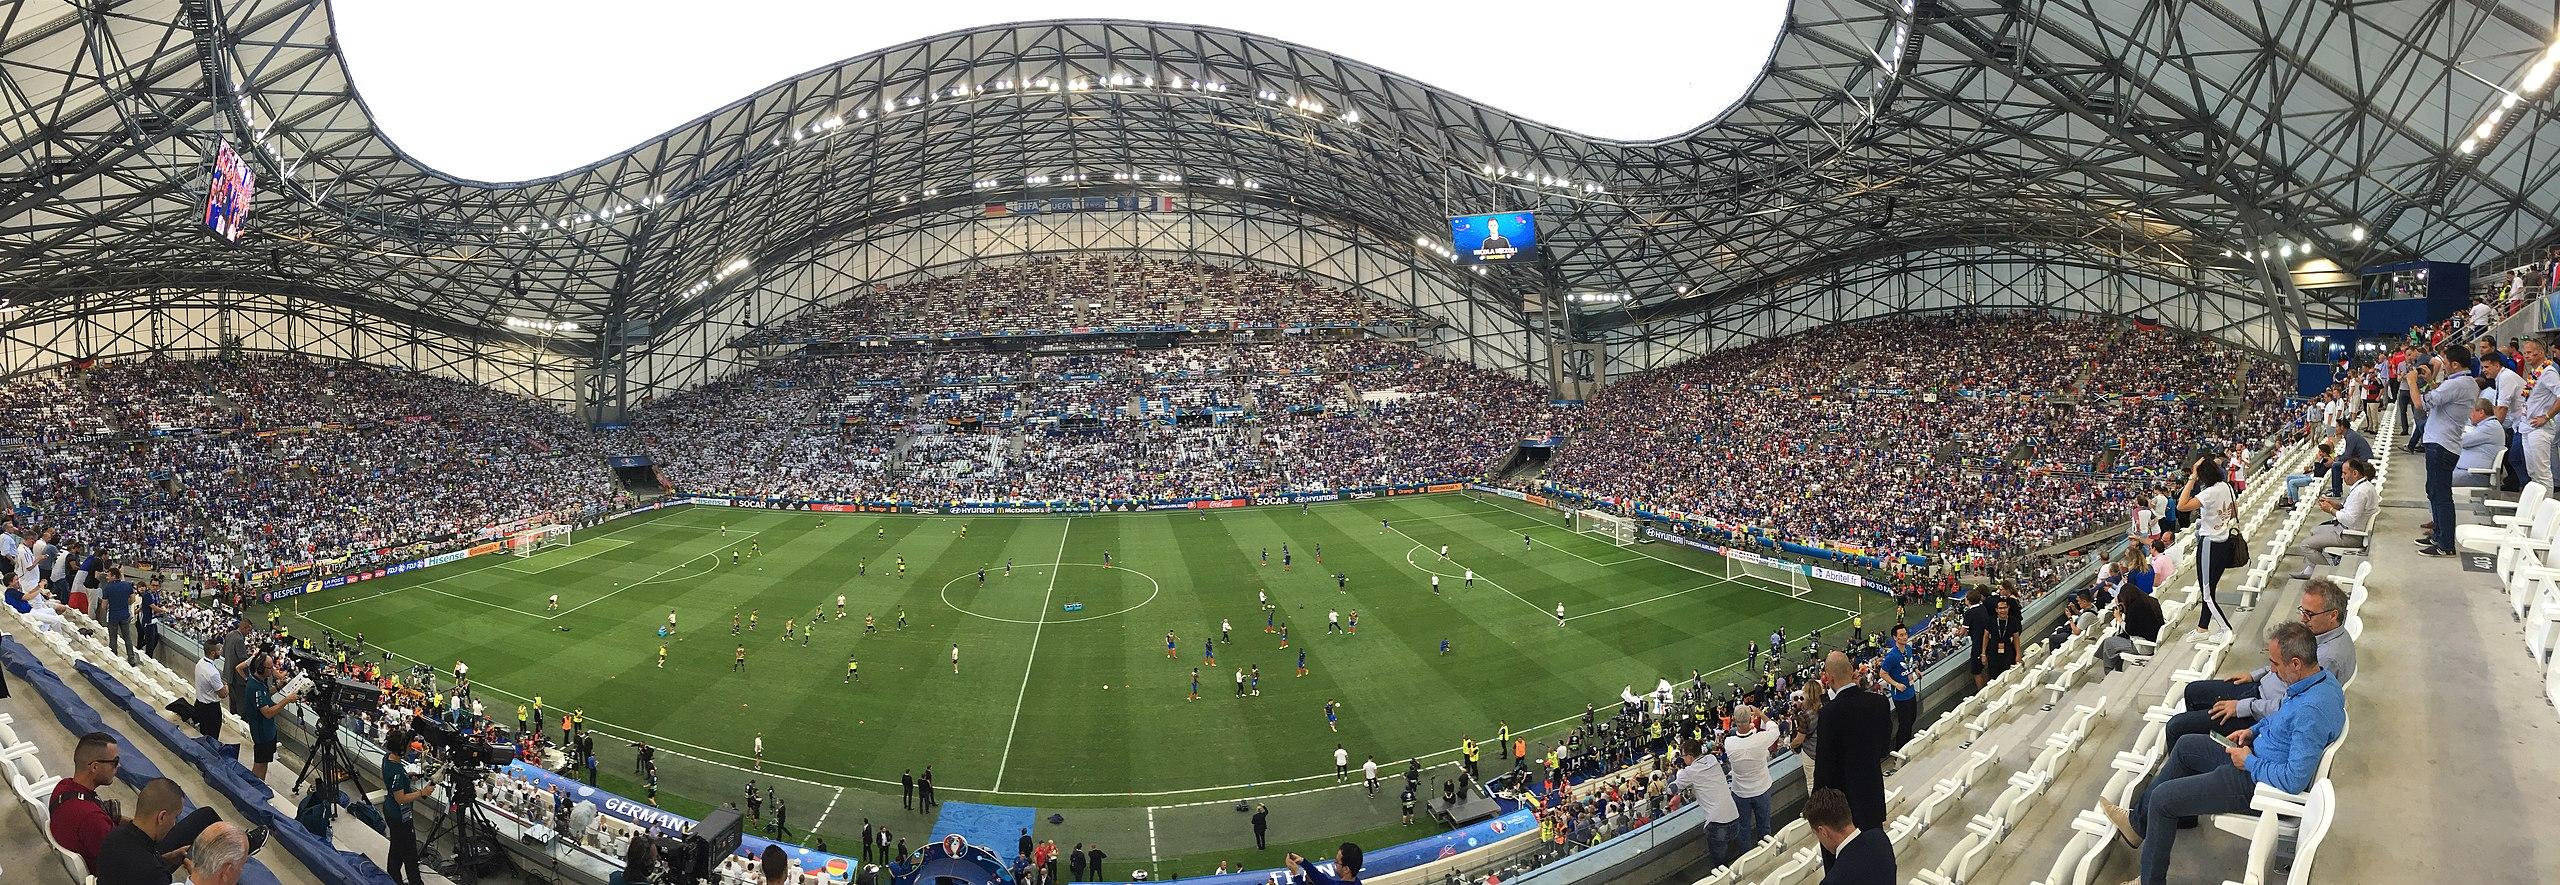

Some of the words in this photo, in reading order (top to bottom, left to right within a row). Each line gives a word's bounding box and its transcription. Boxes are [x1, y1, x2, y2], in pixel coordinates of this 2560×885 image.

[1018, 202, 1039, 211] FIFA
[1052, 202, 1072, 210] UEFA
[2453, 320, 2460, 329] 10
[1256, 497, 1289, 505] SOCAR
[1306, 494, 1338, 502] HYUNDAI
[550, 525, 573, 537] SOCAR
[1655, 531, 1684, 546] HYUNDAI
[429, 552, 465, 566] Hisense
[406, 562, 417, 570] FDJ
[387, 567, 398, 575] FDJ
[331, 576, 345, 584] POSTE
[1825, 570, 1858, 584] Abritel.fr
[1866, 580, 1876, 589] NO
[1876, 583, 1884, 591] TO
[273, 586, 303, 600] RESPECT
[605, 798, 699, 833] GERMANY
